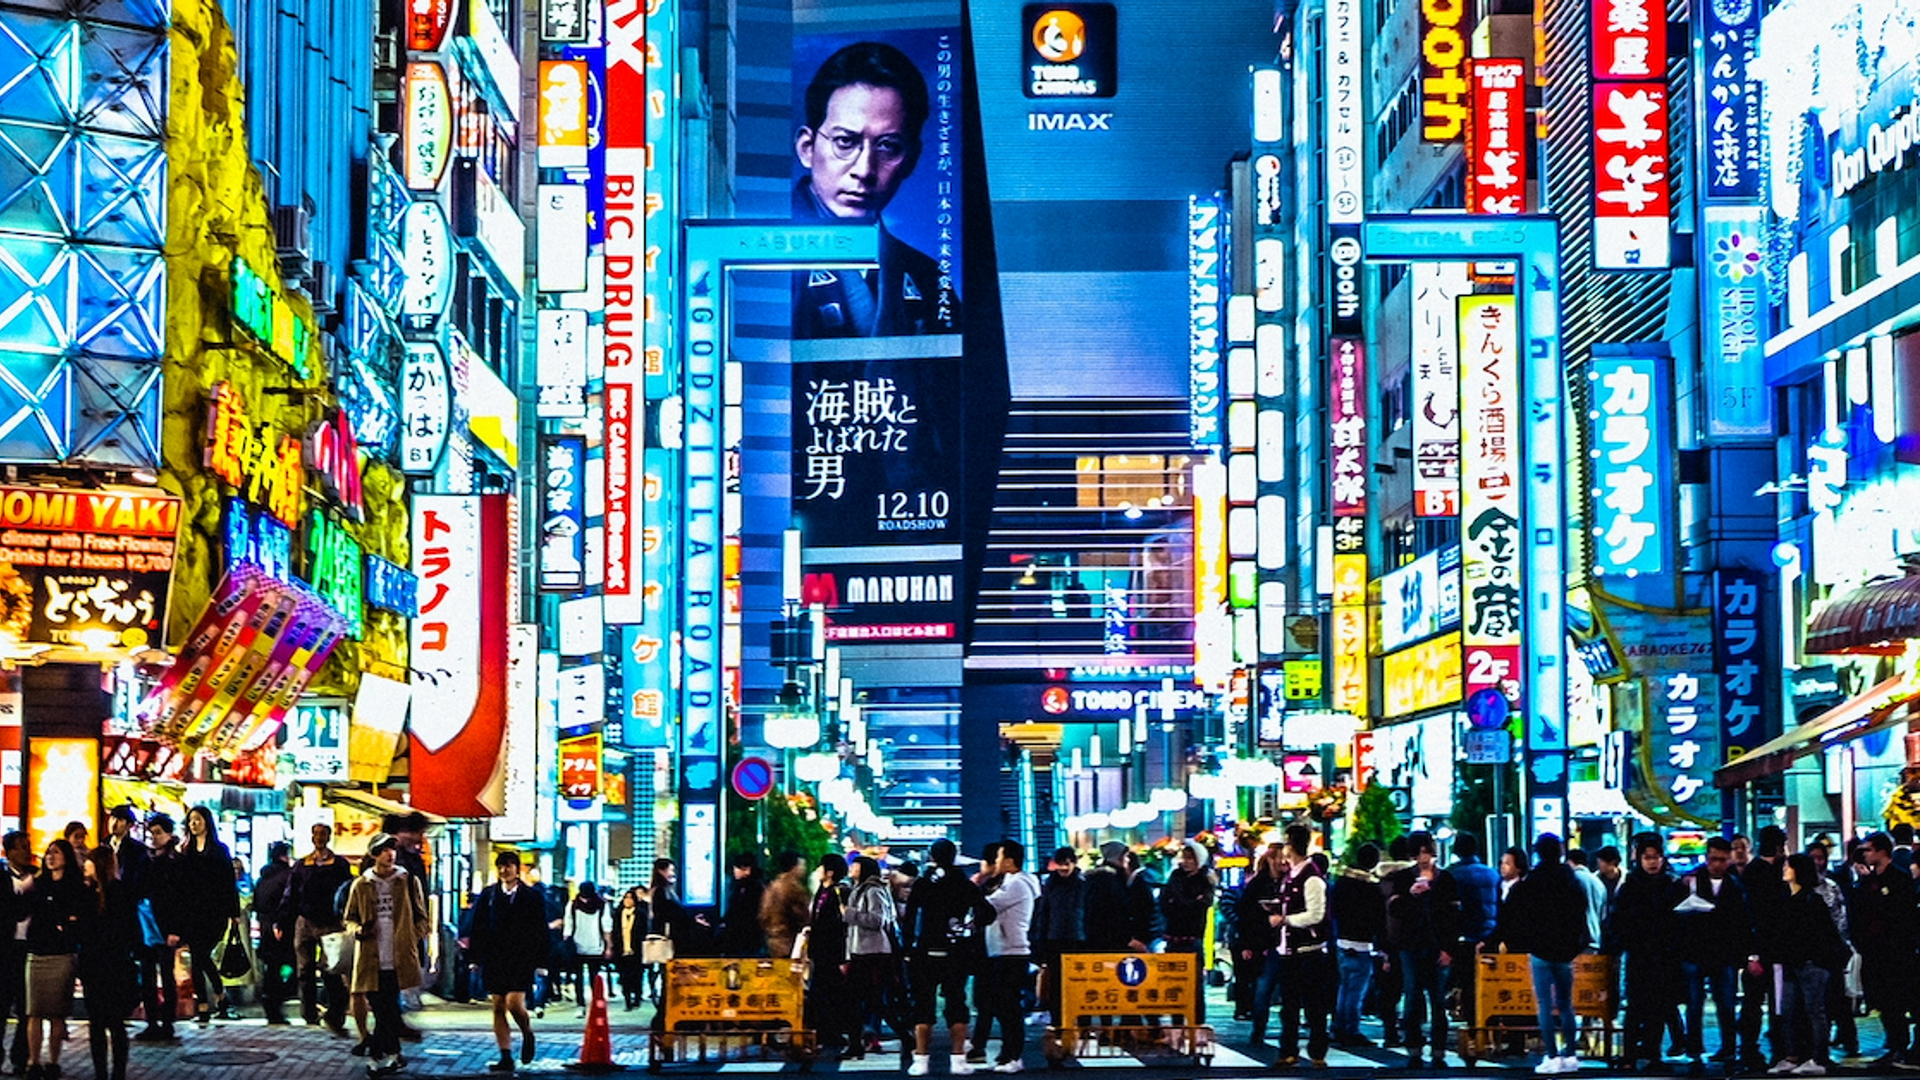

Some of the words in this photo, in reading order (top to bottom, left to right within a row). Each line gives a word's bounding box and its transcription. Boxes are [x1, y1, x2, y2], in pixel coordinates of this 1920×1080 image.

[1028, 112, 1113, 130] IMAX
[1832, 146, 1865, 199] Don
[605, 175, 634, 240] BIC
[604, 256, 633, 367] DRUG
[1739, 289, 1758, 348] IDOL
[805, 378, 918, 426] 海賊と
[1480, 306, 1507, 463] きんくら酒場
[1722, 386, 1756, 409] 5F
[689, 307, 714, 559] GODZILLA
[805, 425, 909, 454] よばれた
[804, 455, 847, 500] 男
[1602, 365, 1656, 565] カラオケ
[0, 490, 77, 527] OMI
[88, 496, 179, 533] YAKI
[877, 490, 950, 519] 12.10
[1336, 518, 1364, 533] 4F
[1, 530, 48, 546] dinner
[50, 532, 82, 548] with
[70, 551, 82, 567] 2
[83, 551, 125, 569] hours
[1335, 533, 1364, 549] 3F
[420, 510, 451, 652] トラノコ
[847, 575, 953, 603] MARUHAN
[1468, 507, 1520, 638] 金の蔵
[689, 590, 714, 708] ROAD
[1724, 579, 1760, 737] カラオケ
[1667, 672, 1704, 803] カラオケ
